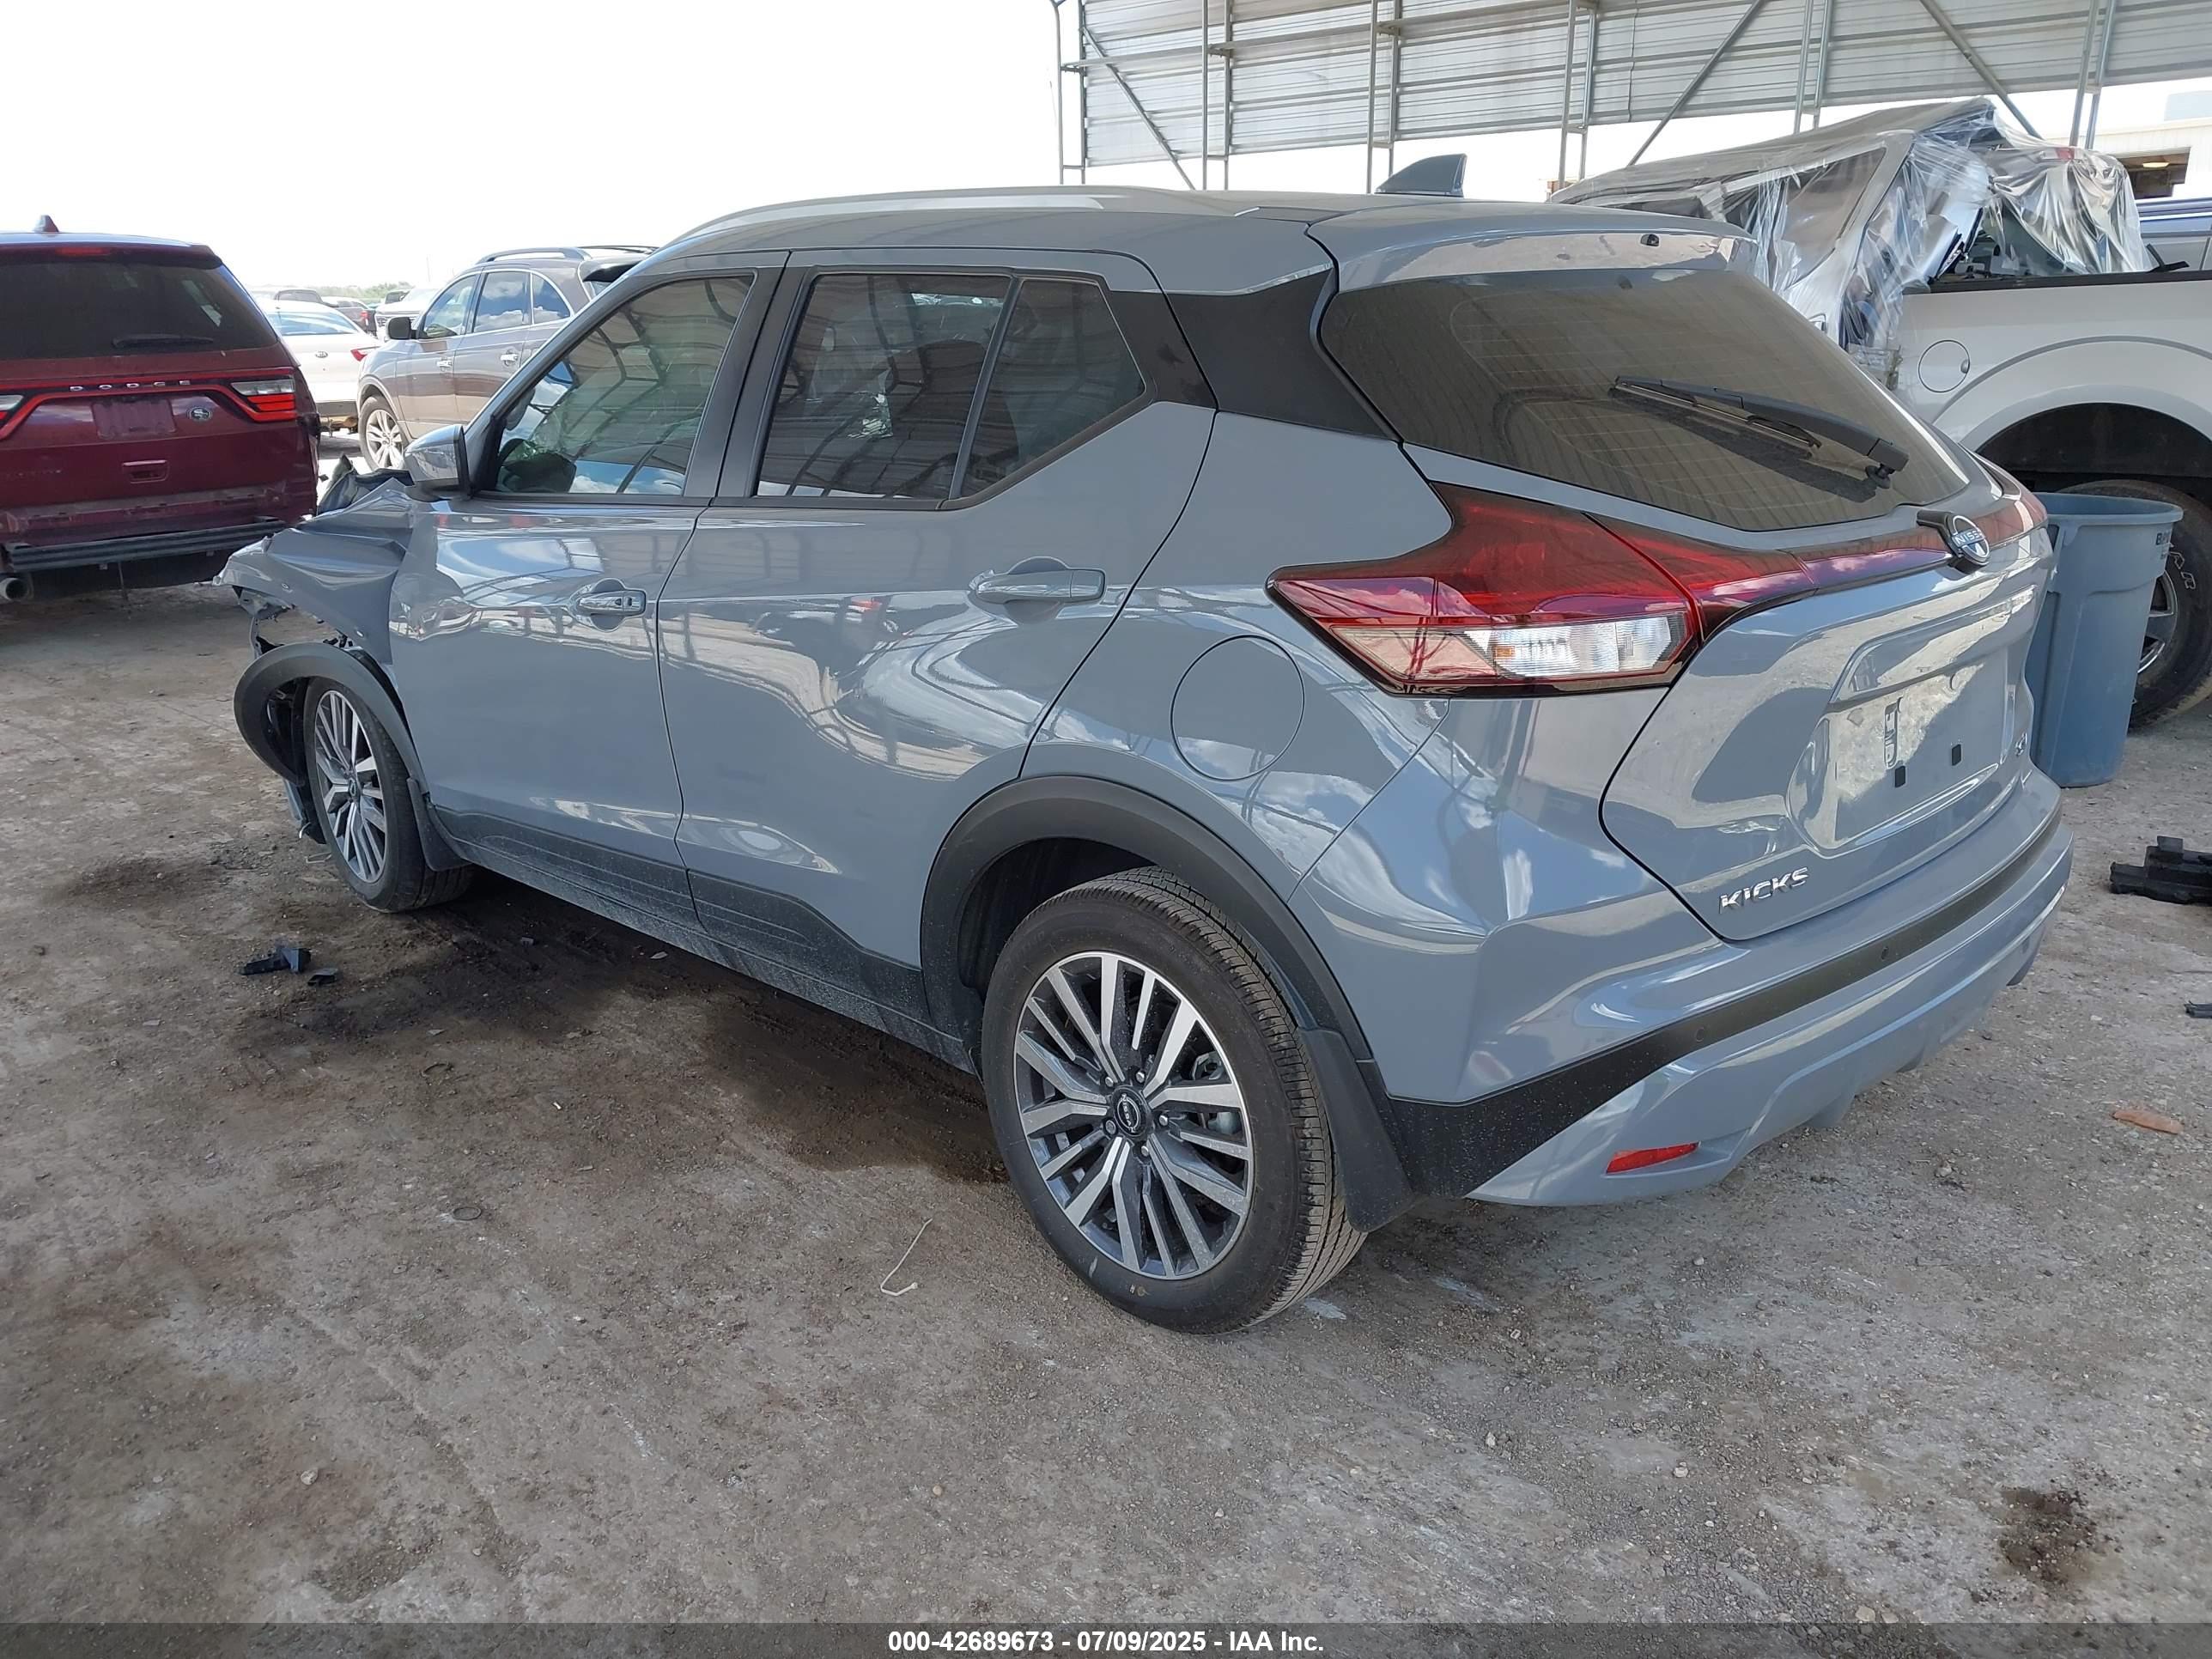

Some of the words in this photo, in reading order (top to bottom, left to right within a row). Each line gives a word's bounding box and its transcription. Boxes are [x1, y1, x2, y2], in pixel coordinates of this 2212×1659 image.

[70, 379, 191, 392] DODGE
[1954, 529, 1984, 545] NISS
[1719, 866, 1808, 910] KICKS
[1121, 1092, 1136, 1133] NISSAN
